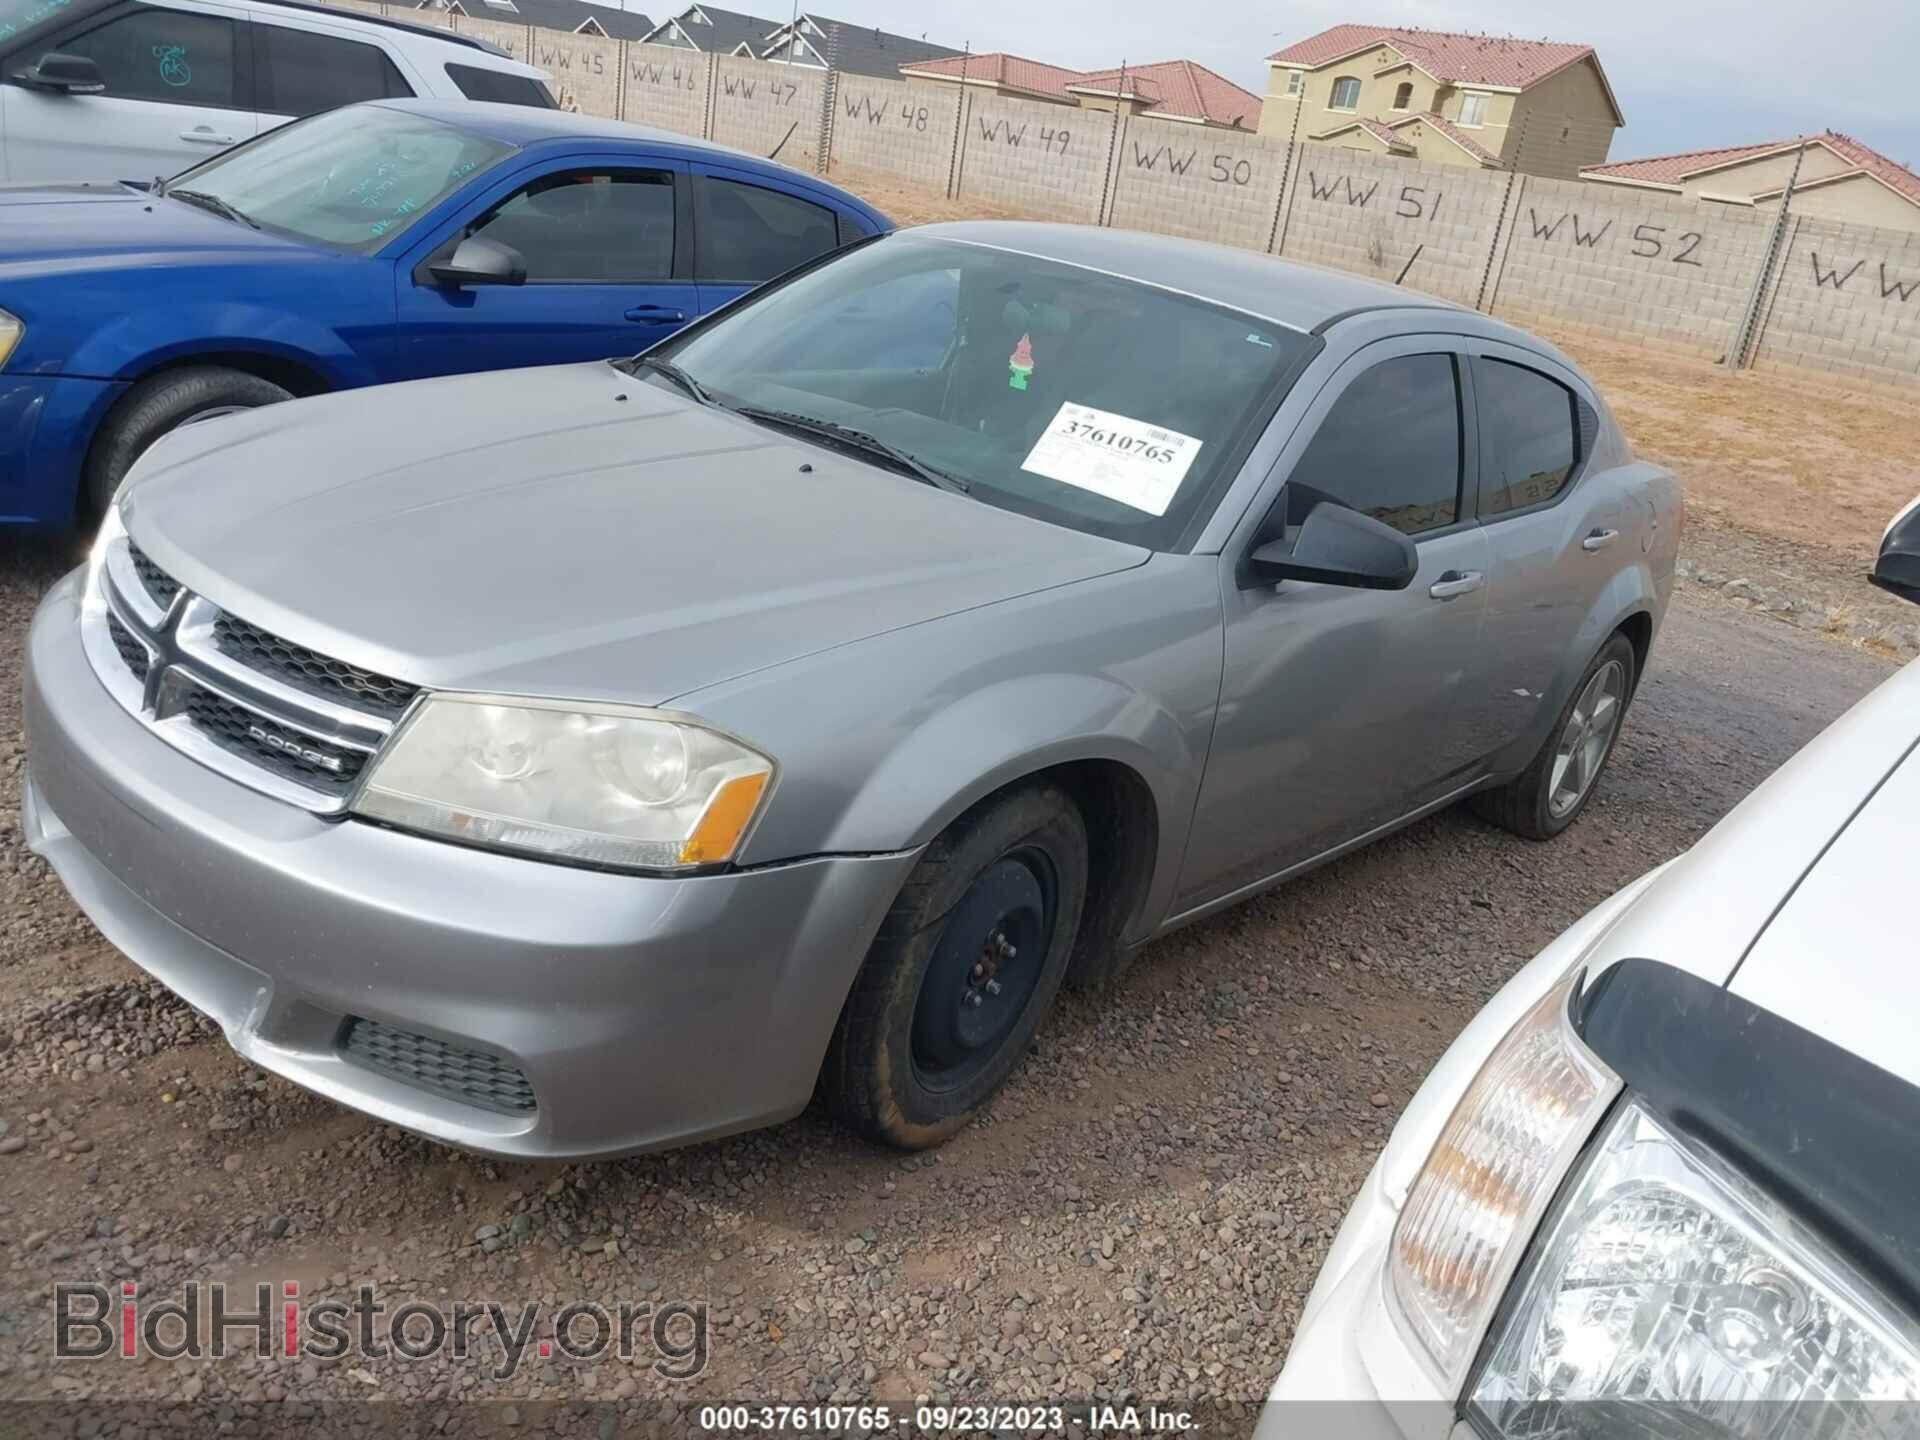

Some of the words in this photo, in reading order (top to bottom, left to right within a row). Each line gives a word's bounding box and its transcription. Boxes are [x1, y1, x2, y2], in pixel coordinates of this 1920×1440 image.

[541, 44, 572, 70] WW
[581, 53, 604, 75] 45
[632, 60, 665, 86] WW
[671, 68, 696, 91] 46
[724, 75, 758, 100] WW
[771, 83, 798, 107] 47
[844, 94, 889, 127] WW
[901, 104, 929, 133] 48
[978, 116, 1027, 148] WW
[1039, 126, 1071, 156] 49
[1133, 141, 1198, 176] WW
[1209, 155, 1252, 186] 50
[1308, 170, 1379, 208] WW
[1395, 186, 1443, 222] 51
[1529, 207, 1613, 248] WW
[1630, 224, 1703, 267] 52
[1063, 421, 1176, 464] 37610765
[249, 726, 340, 771] DODGE
